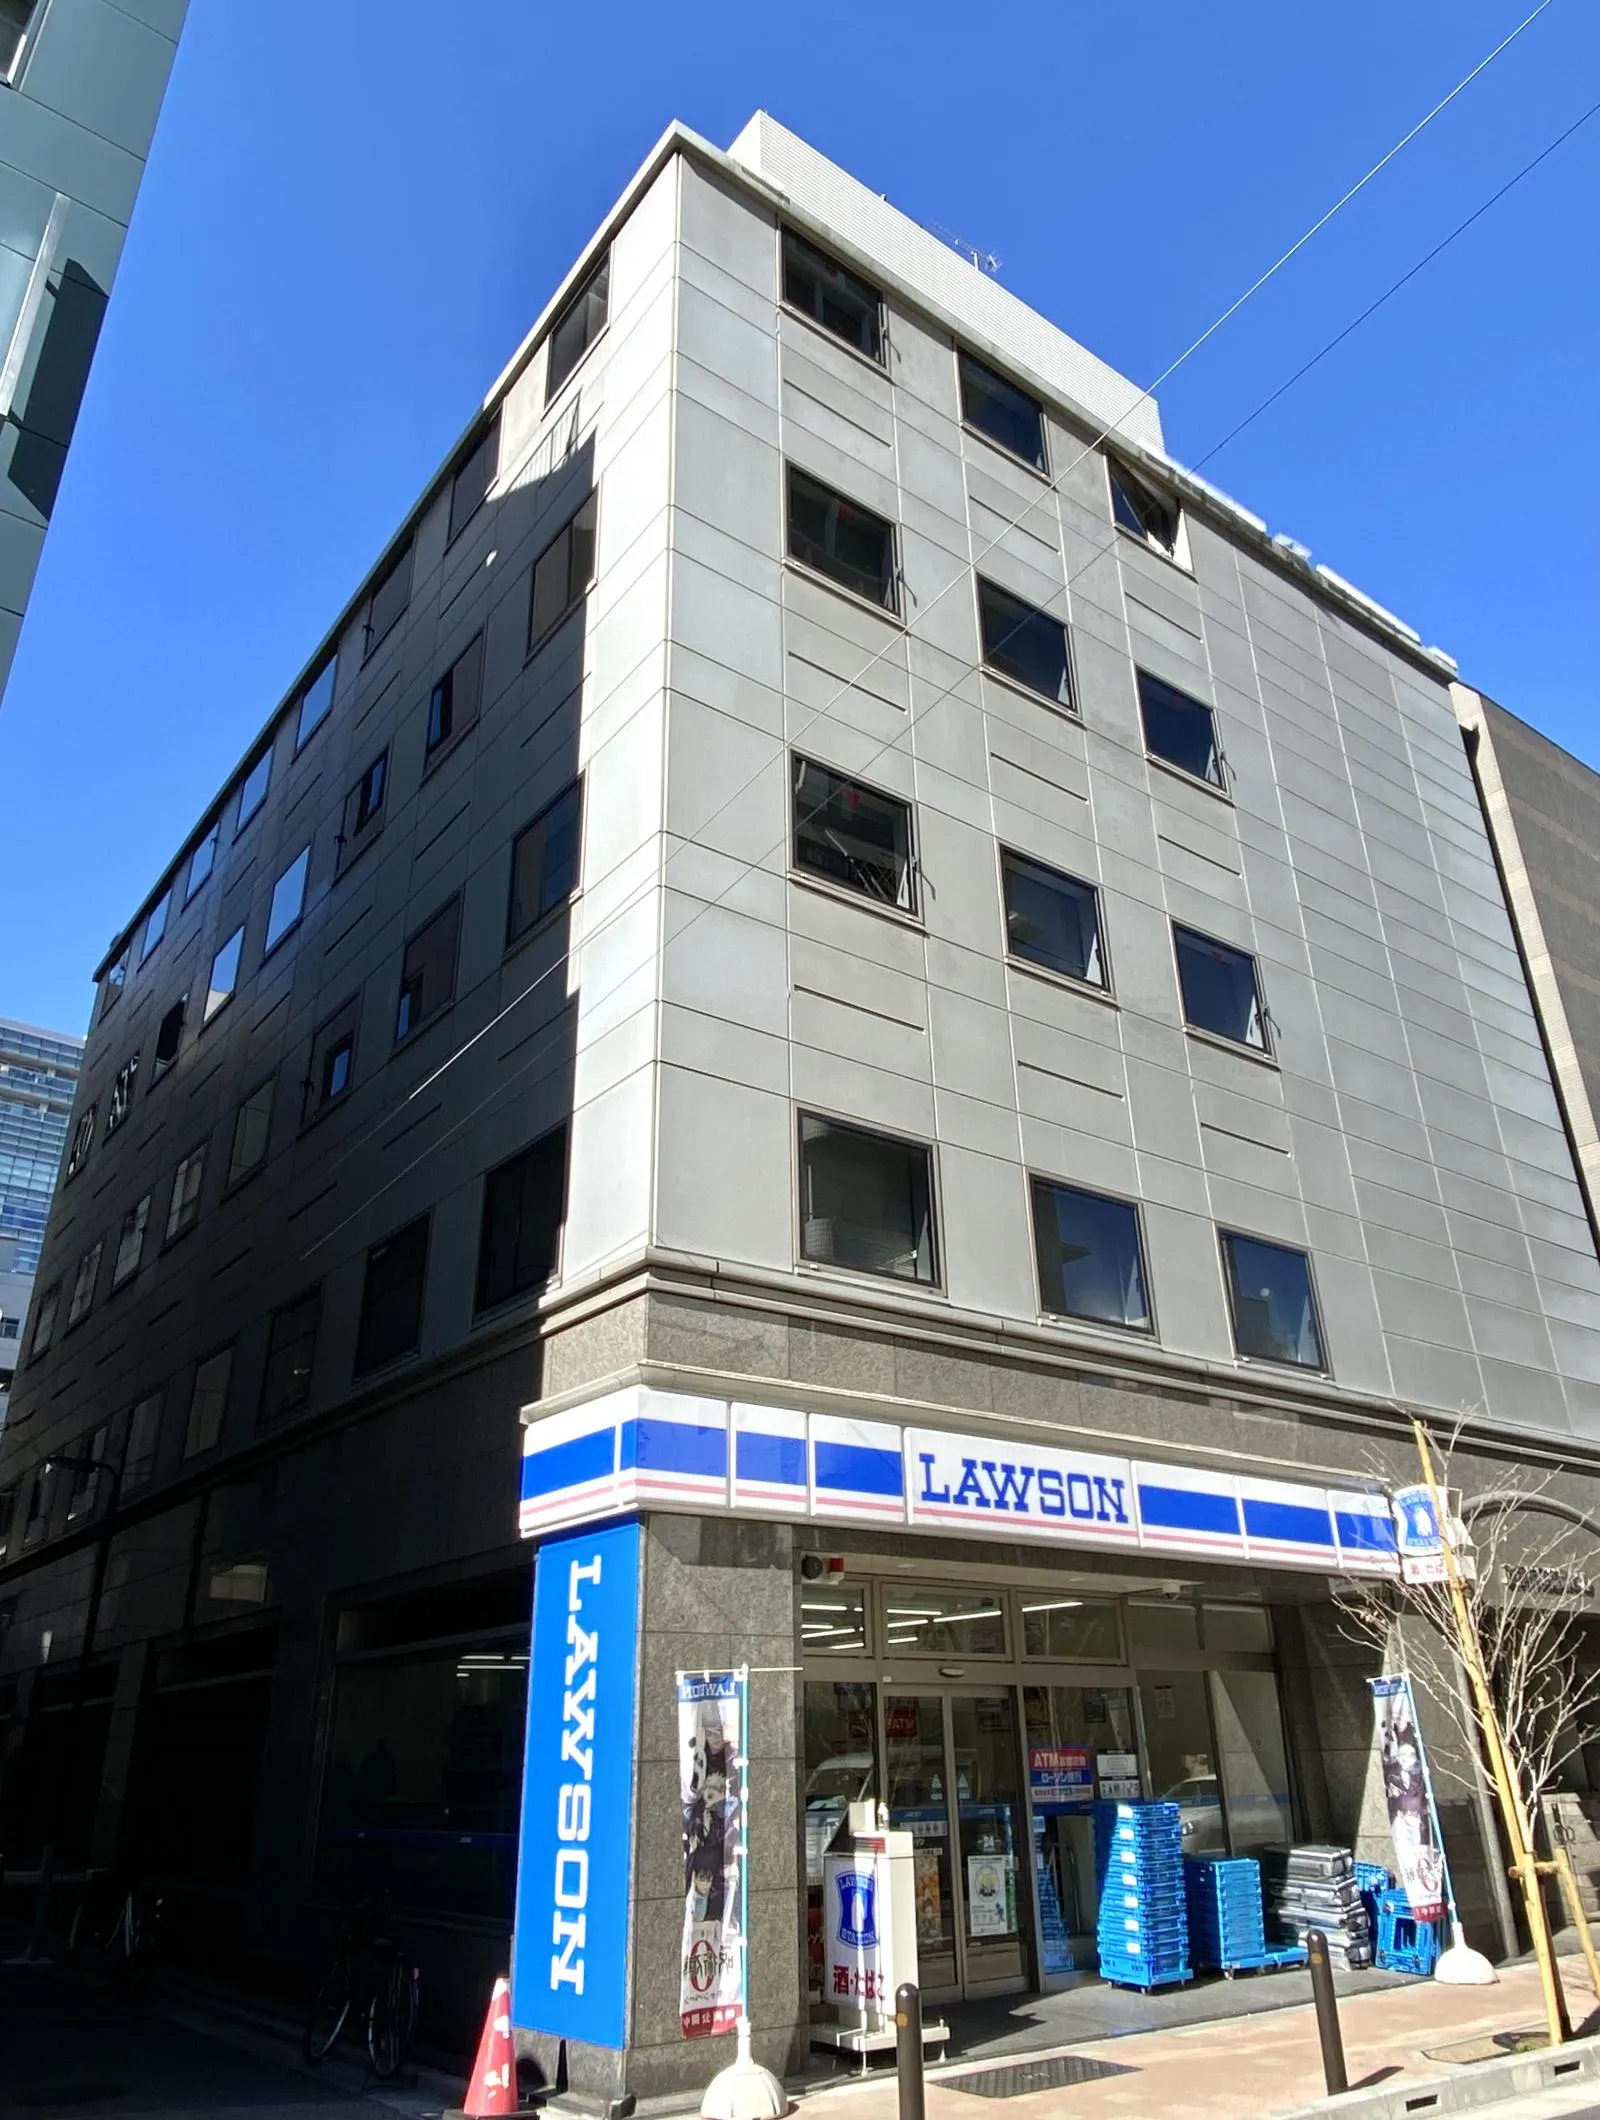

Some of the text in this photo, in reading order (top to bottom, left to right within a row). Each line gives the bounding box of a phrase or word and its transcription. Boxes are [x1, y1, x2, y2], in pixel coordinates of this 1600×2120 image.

[919, 1453, 1129, 1524] LAWSON
[550, 1555, 602, 1996] LAWSON
[1033, 1751, 1059, 1768] ATM
